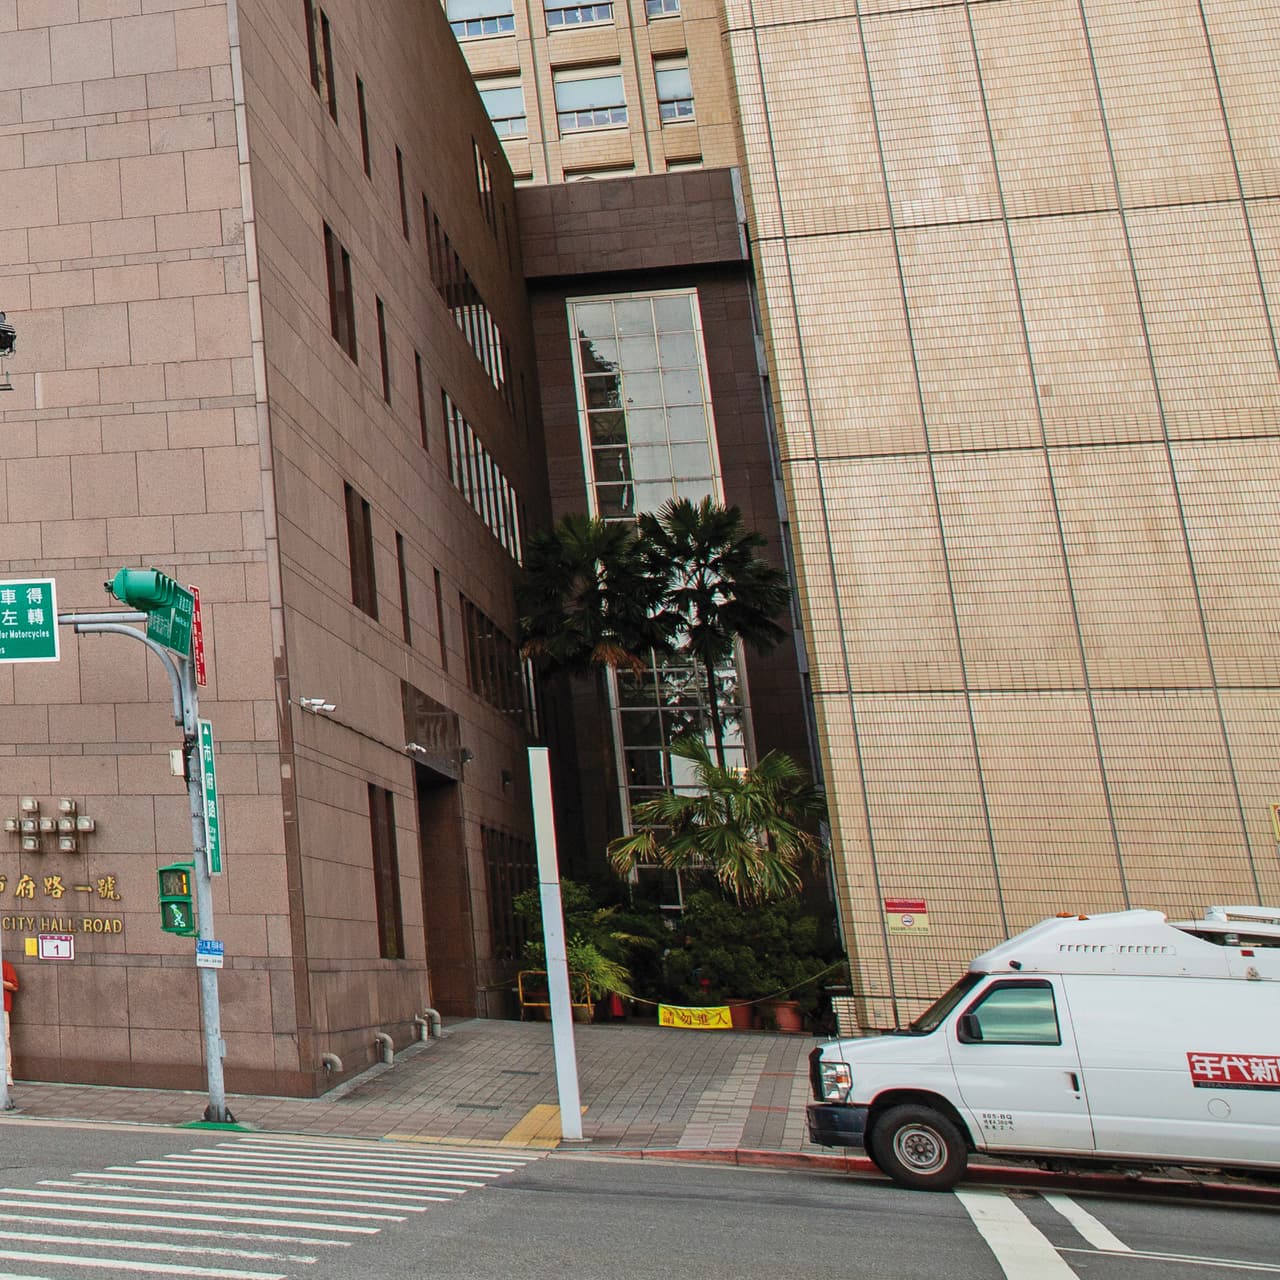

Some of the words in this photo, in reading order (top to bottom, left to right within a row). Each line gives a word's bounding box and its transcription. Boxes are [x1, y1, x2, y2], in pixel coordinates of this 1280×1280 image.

[0, 630, 9, 639] for
[9, 629, 49, 641] Motorcycles
[2, 917, 35, 931] CITY
[41, 918, 76, 932] HALL
[83, 919, 123, 933] ROAD
[1191, 1055, 1280, 1082] 年代新
